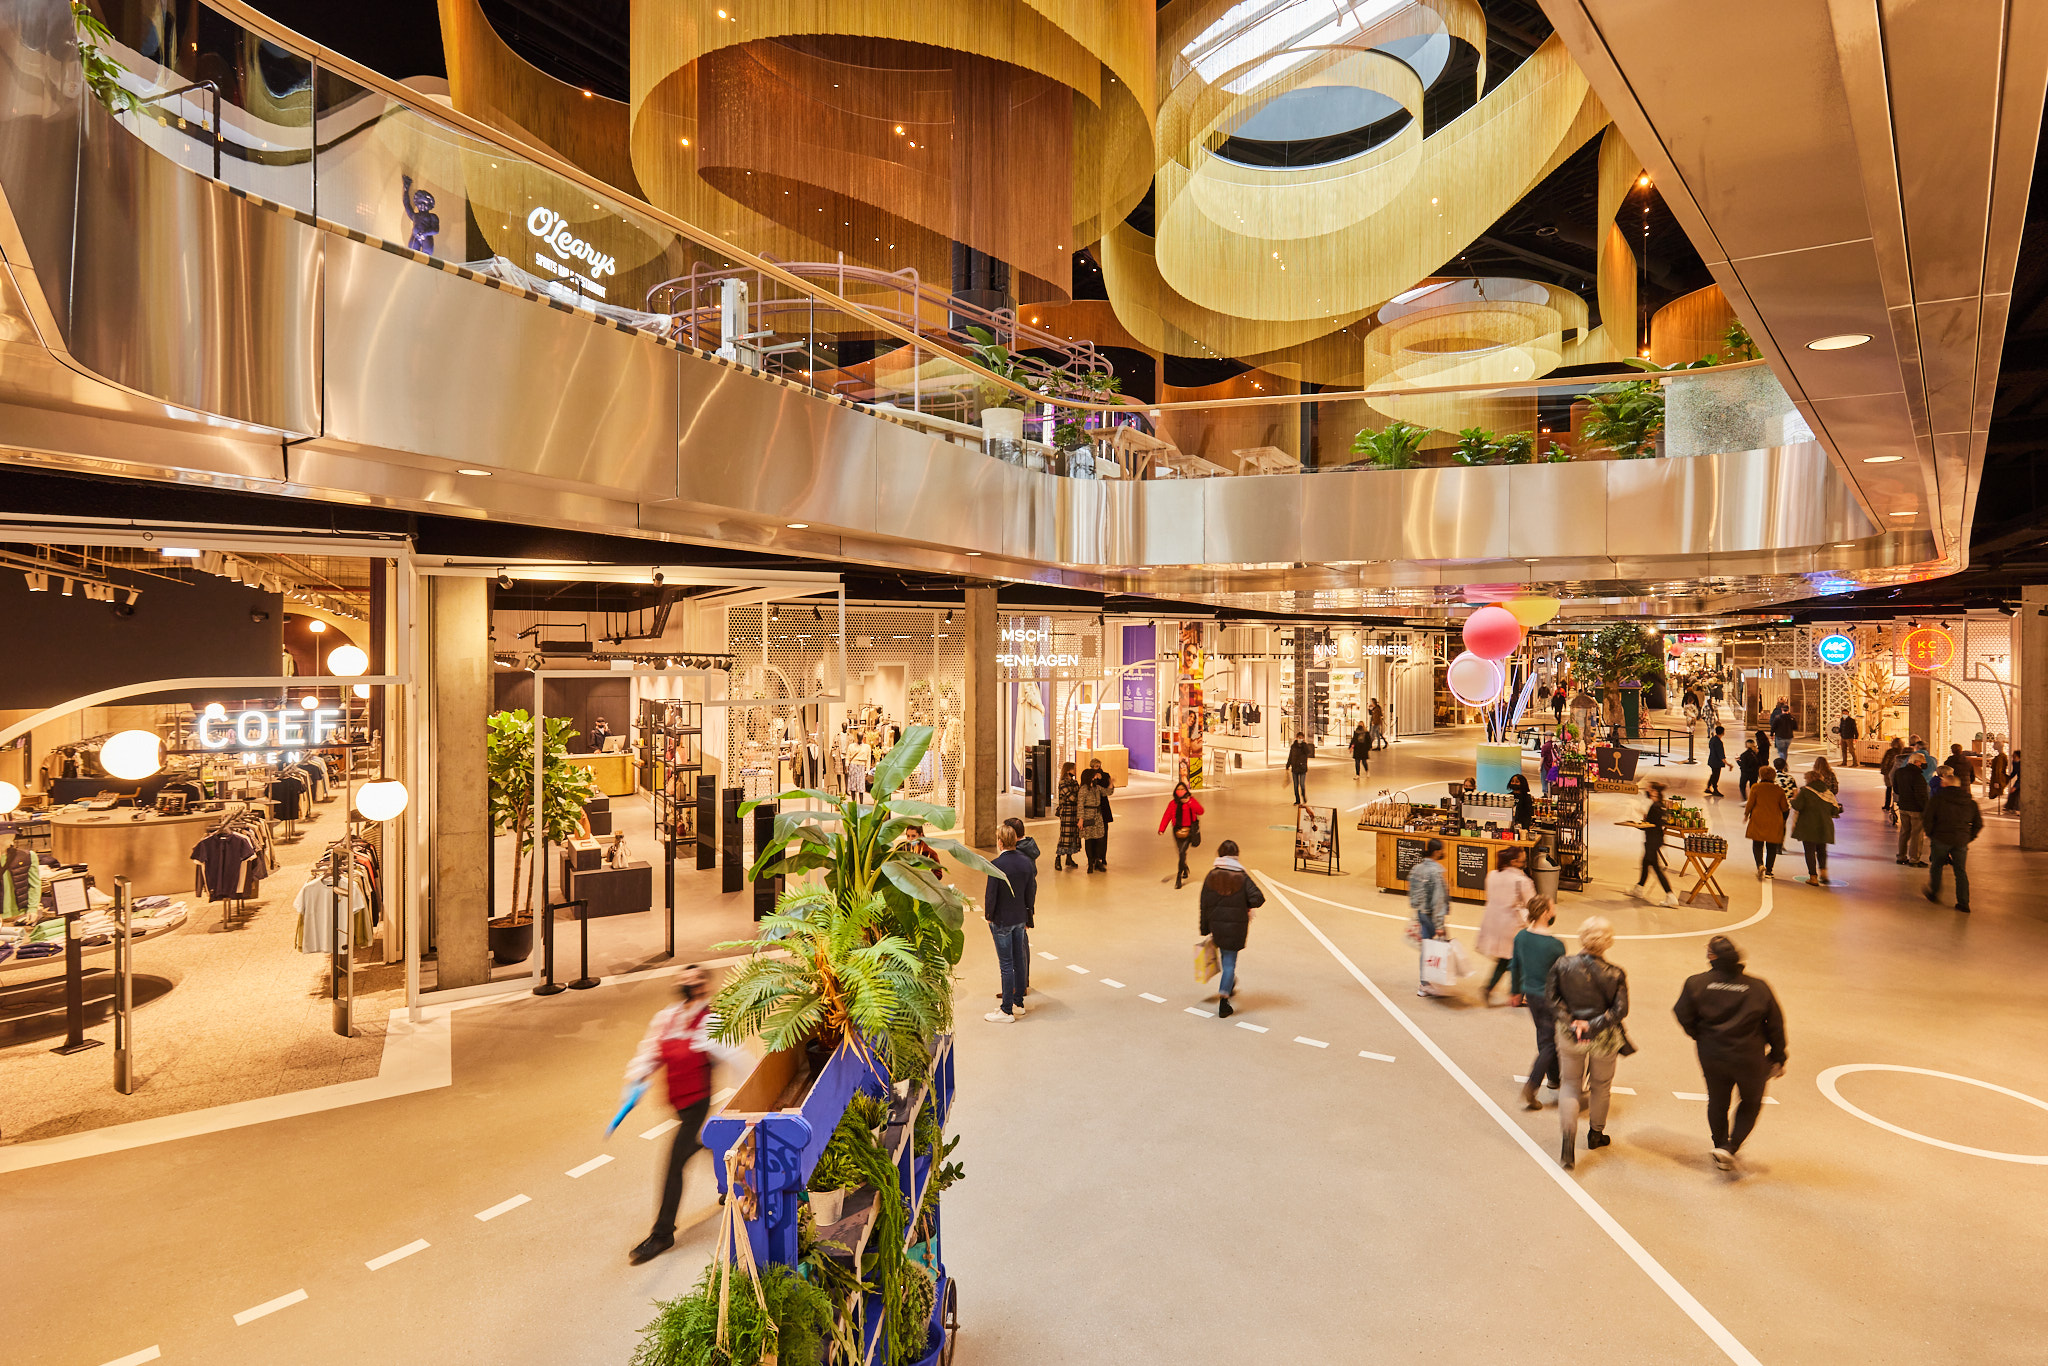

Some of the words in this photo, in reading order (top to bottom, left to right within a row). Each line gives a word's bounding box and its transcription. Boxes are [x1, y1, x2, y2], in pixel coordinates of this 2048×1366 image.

[527, 206, 615, 279] O'Learys
[1001, 629, 1048, 642] MSCH
[1824, 642, 1846, 651] ABC
[996, 654, 1078, 667] PENHAGEN
[200, 709, 340, 748] COEF
[243, 752, 300, 764] MEN
[1596, 783, 1620, 791] CHCO
